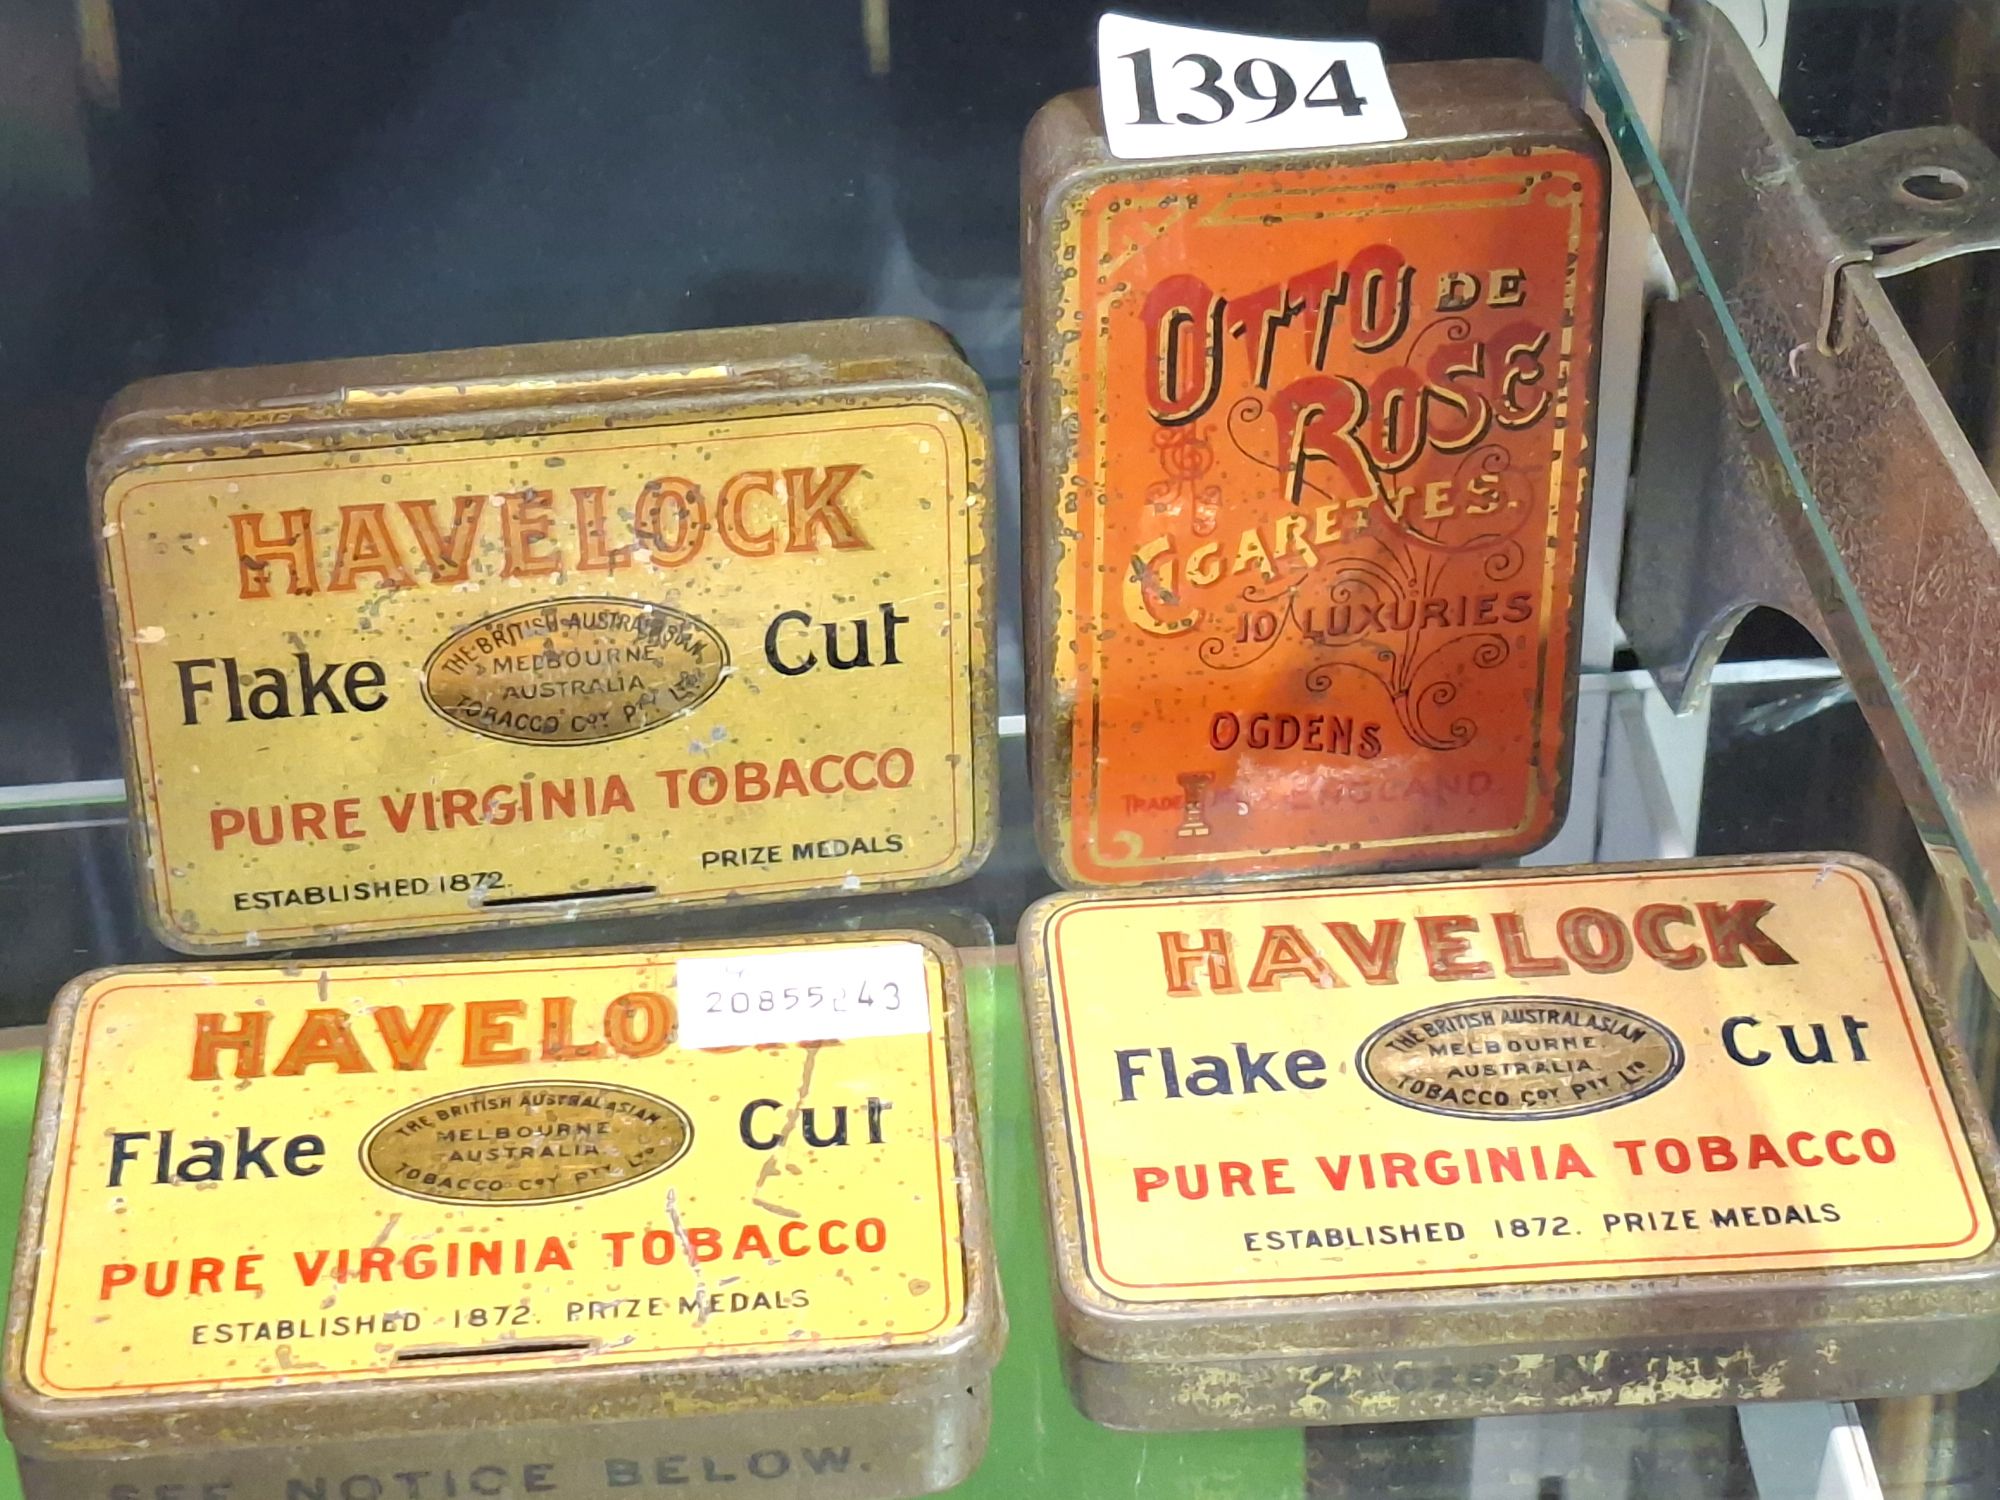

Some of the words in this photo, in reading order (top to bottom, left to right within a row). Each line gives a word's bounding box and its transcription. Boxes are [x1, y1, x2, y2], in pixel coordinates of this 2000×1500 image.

[1117, 48, 1369, 126] 1394
[1137, 243, 1416, 428] OTTO
[1436, 267, 1527, 312] DE
[1266, 320, 1553, 512] ROSE
[227, 463, 875, 600] HAVELOCK
[1235, 609, 1278, 644] 10
[1302, 590, 1535, 642] LUXURIES
[172, 652, 389, 726] Flake
[764, 602, 910, 676] Cut
[441, 643, 480, 676] THE
[502, 674, 646, 701] AUSTRALIA
[1208, 710, 1384, 759] OGDENS
[208, 795, 367, 851] PURE
[380, 773, 636, 836] VIRGINIA
[655, 746, 916, 811] TOBACCO
[701, 845, 782, 871] PRIZE
[791, 833, 905, 863] MEDALS
[233, 877, 430, 913] ESTABLISHED
[438, 871, 513, 894] 1872.
[1157, 899, 1800, 999] HAVELOCK
[188, 990, 845, 1082] HAVELO
[1113, 1041, 1328, 1102] Flake
[1721, 1014, 1872, 1068] Cut
[1384, 1028, 1426, 1054] THE
[1423, 1009, 1496, 1038] BRITISH
[1501, 1008, 1648, 1044] AUSTRALASIAN
[395, 1114, 434, 1138] THE
[435, 1095, 513, 1122] BRITISH
[1398, 1074, 1510, 1107] TOBACCO
[106, 1126, 326, 1187] Flake
[739, 1096, 893, 1151] Cut
[448, 1144, 600, 1163] AUSTRALIA
[1132, 1157, 1297, 1203] PURE
[1314, 1144, 1598, 1191] VIRGINIA
[1612, 1127, 1898, 1177] TOBACCO
[394, 1162, 504, 1192] TOBACCO
[1243, 1220, 1466, 1252] ESTABLISHED
[1494, 1216, 1583, 1240] 1872.
[1602, 1209, 1701, 1234] PRIZE
[1711, 1202, 1842, 1229] MEDALS
[100, 1253, 265, 1301] PURE
[293, 1236, 574, 1288] VIRGINIA
[601, 1217, 888, 1268] TOBACCO
[191, 1311, 422, 1346] ESTABLISHED
[453, 1304, 542, 1329] 1872.
[566, 1296, 663, 1323] PRIZE
[678, 1288, 811, 1318] MEDALS
[285, 1461, 559, 1500] NOTICE
[605, 1443, 874, 1489] BELOW.
